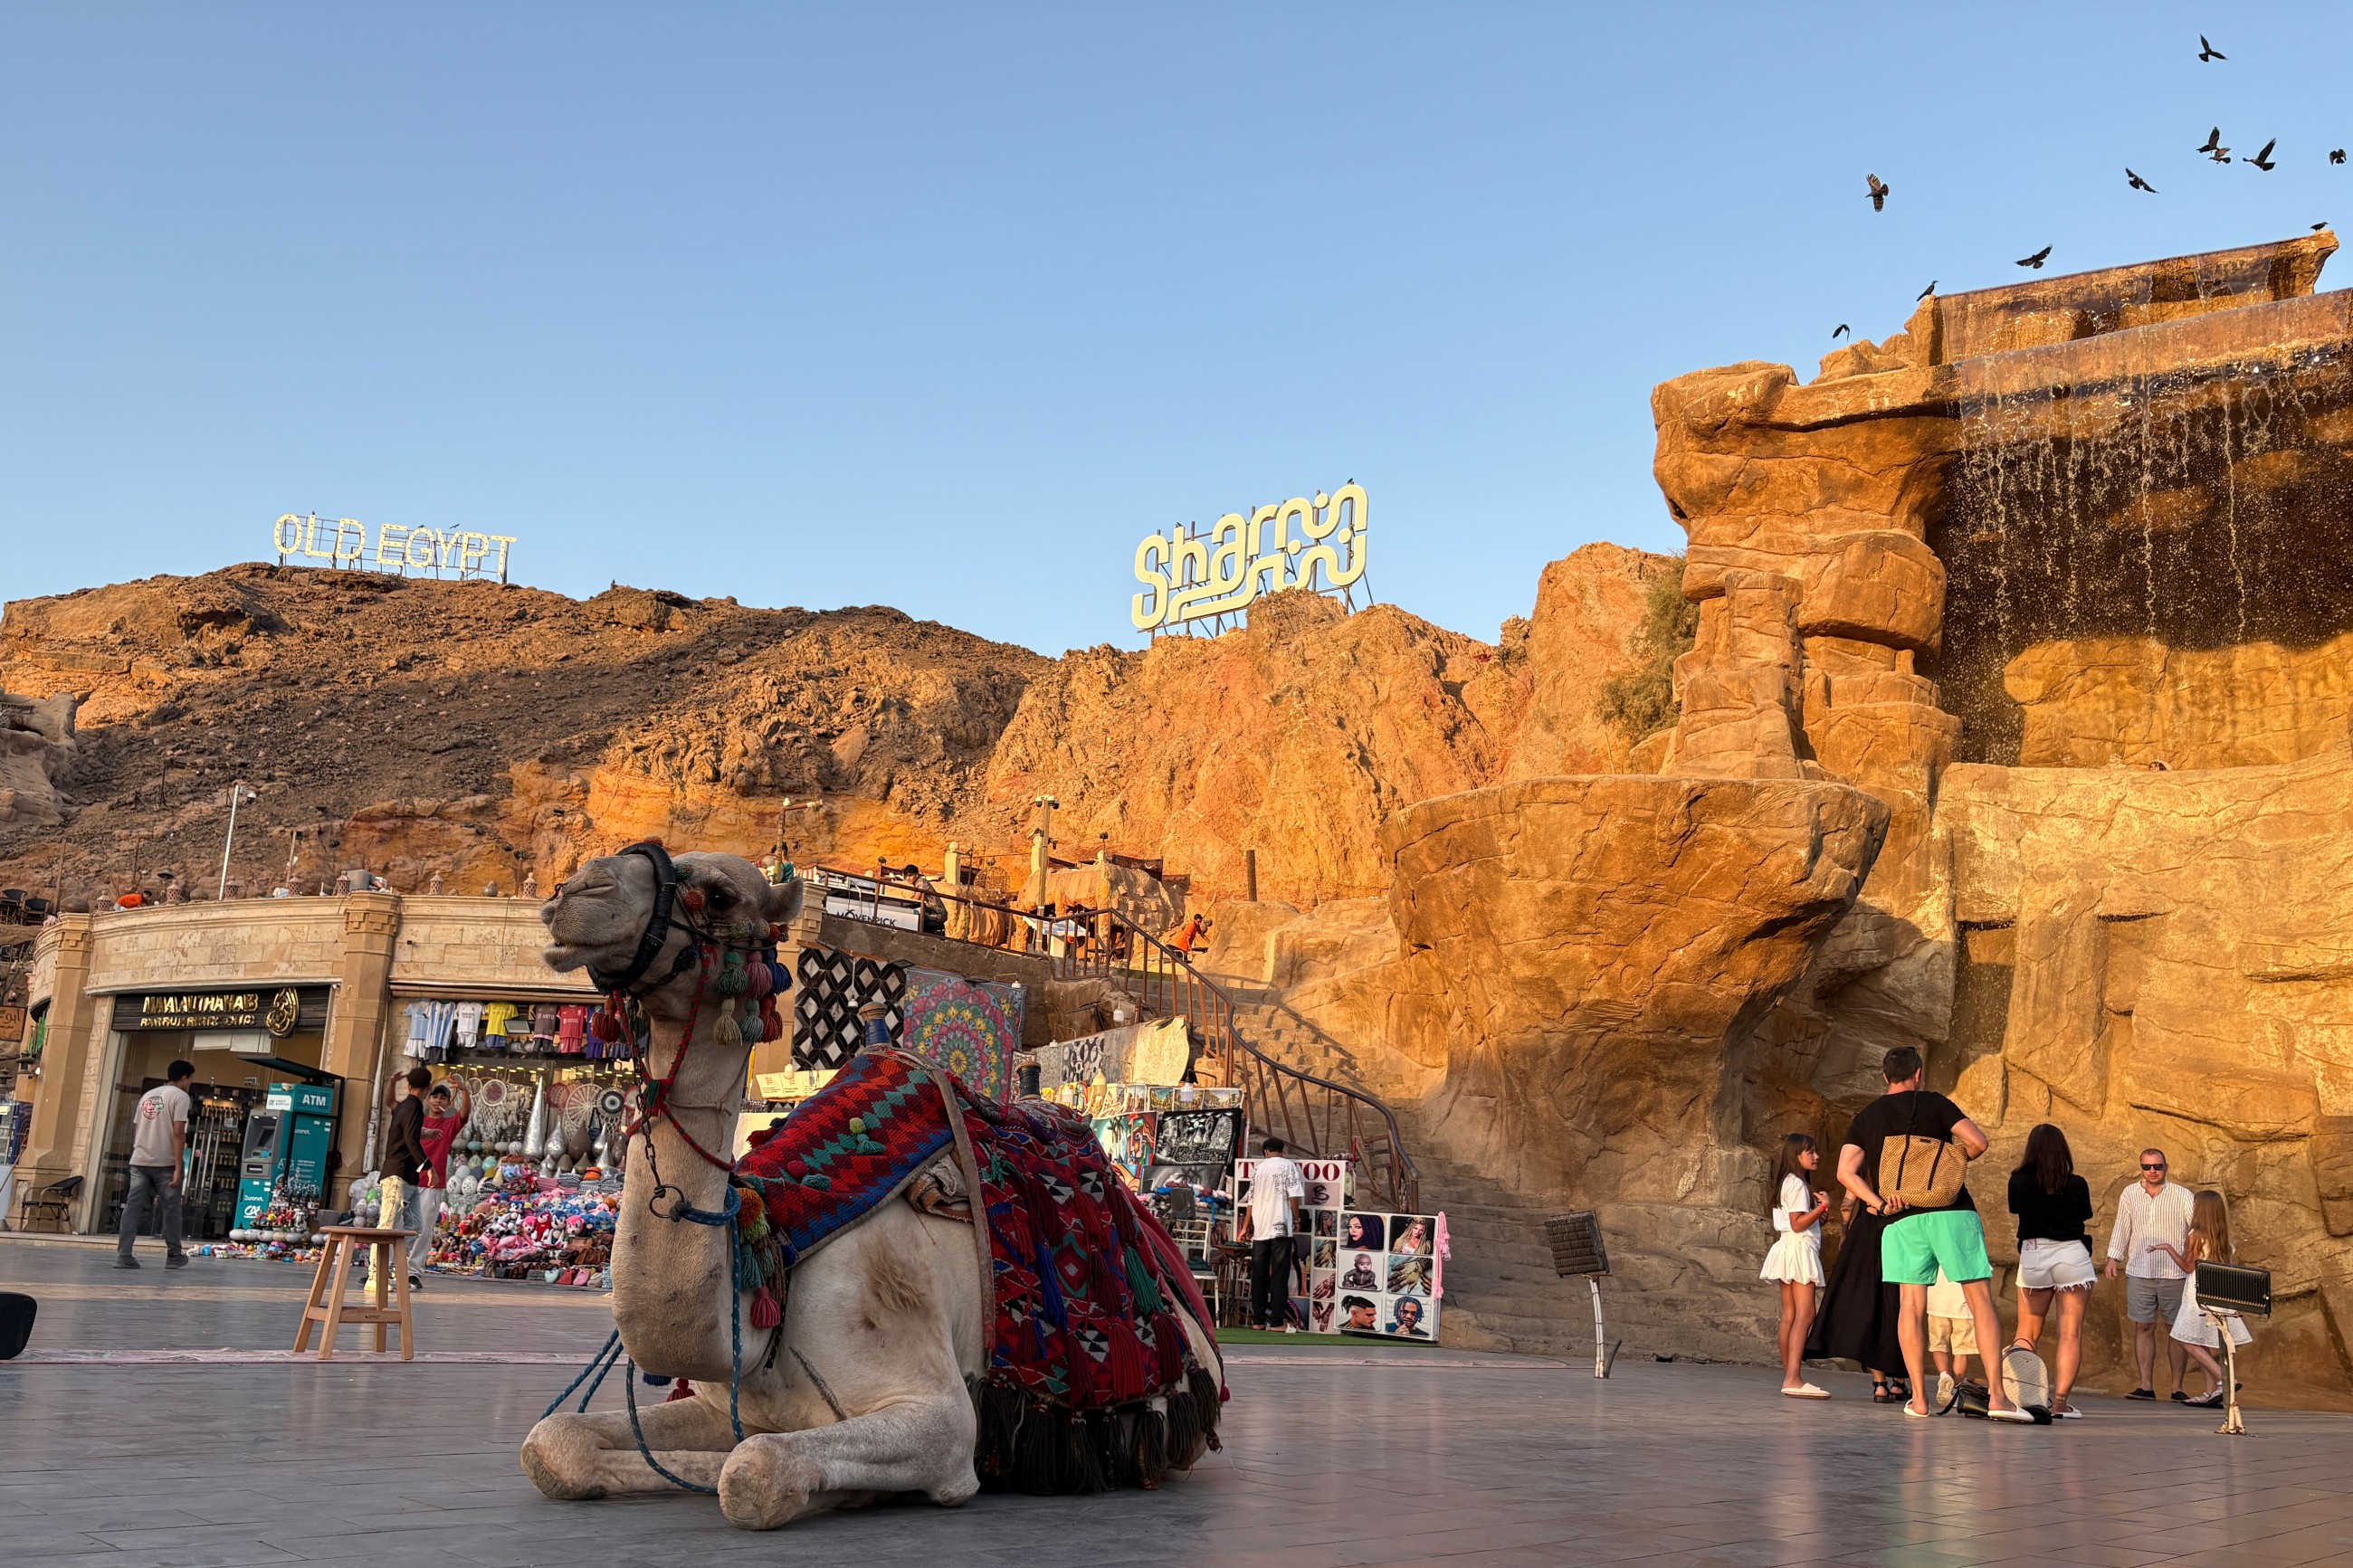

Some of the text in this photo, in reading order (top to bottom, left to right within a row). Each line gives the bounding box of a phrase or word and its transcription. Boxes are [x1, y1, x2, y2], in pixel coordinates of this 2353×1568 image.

[274, 513, 518, 577] OLD EGYPT
[1131, 484, 1368, 630] Sharm
[302, 1094, 326, 1107] ATM
[1238, 1162, 1339, 1181] TOO
